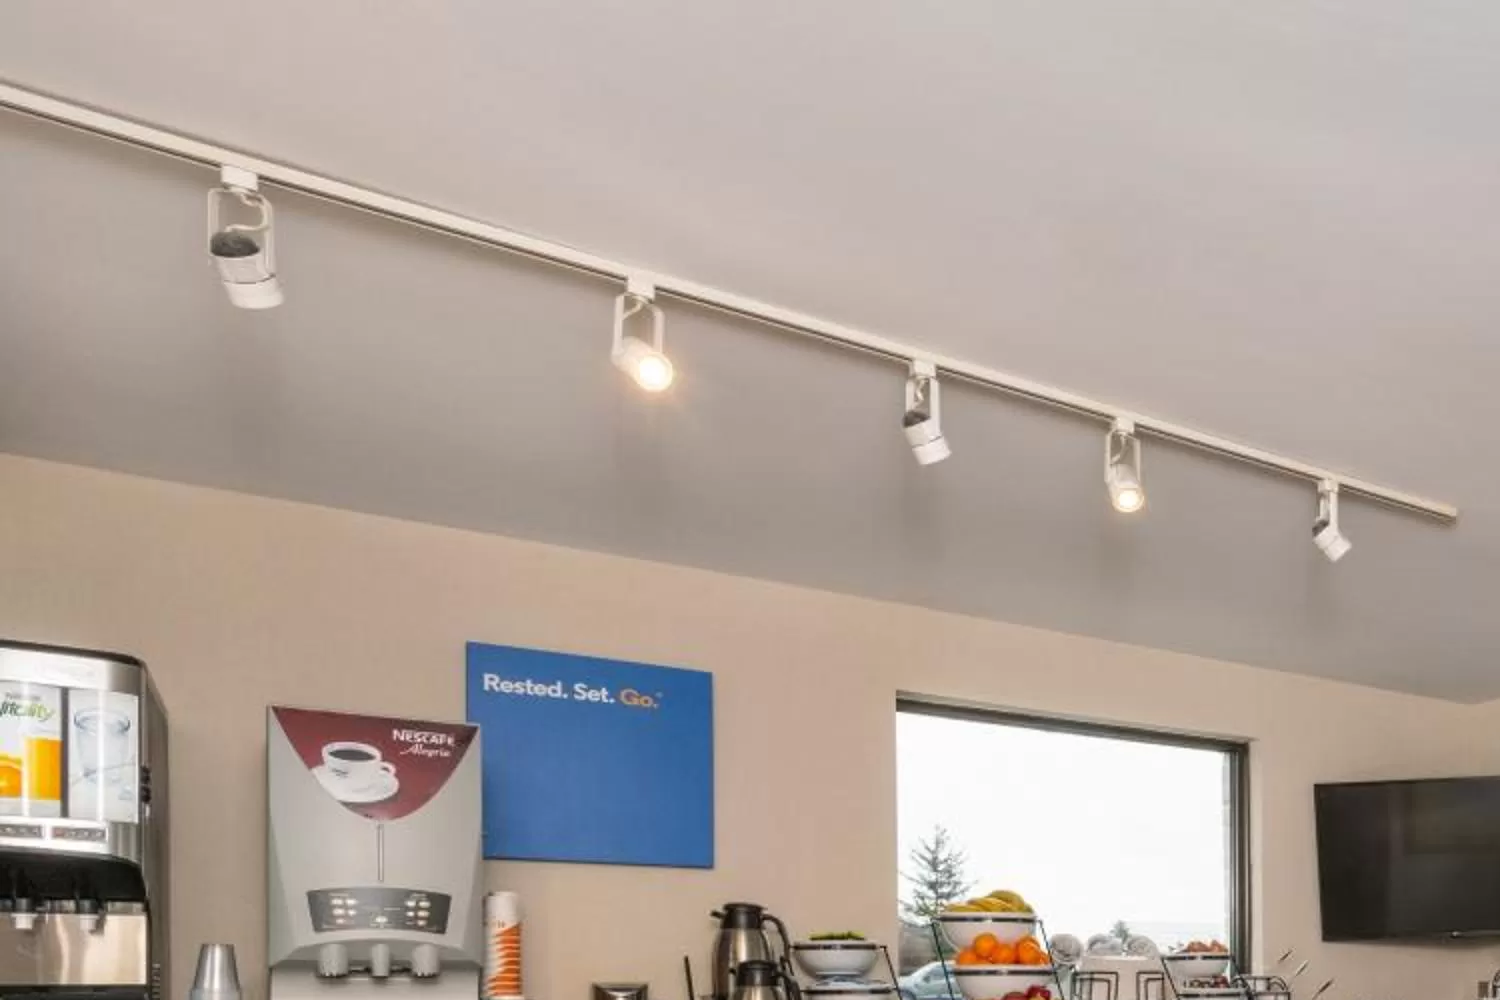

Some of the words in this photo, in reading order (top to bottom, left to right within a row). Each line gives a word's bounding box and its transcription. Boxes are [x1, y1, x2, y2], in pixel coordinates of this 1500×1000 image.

[482, 672, 568, 699] Rested.
[573, 682, 616, 704] Set.
[619, 688, 659, 709] Go.
